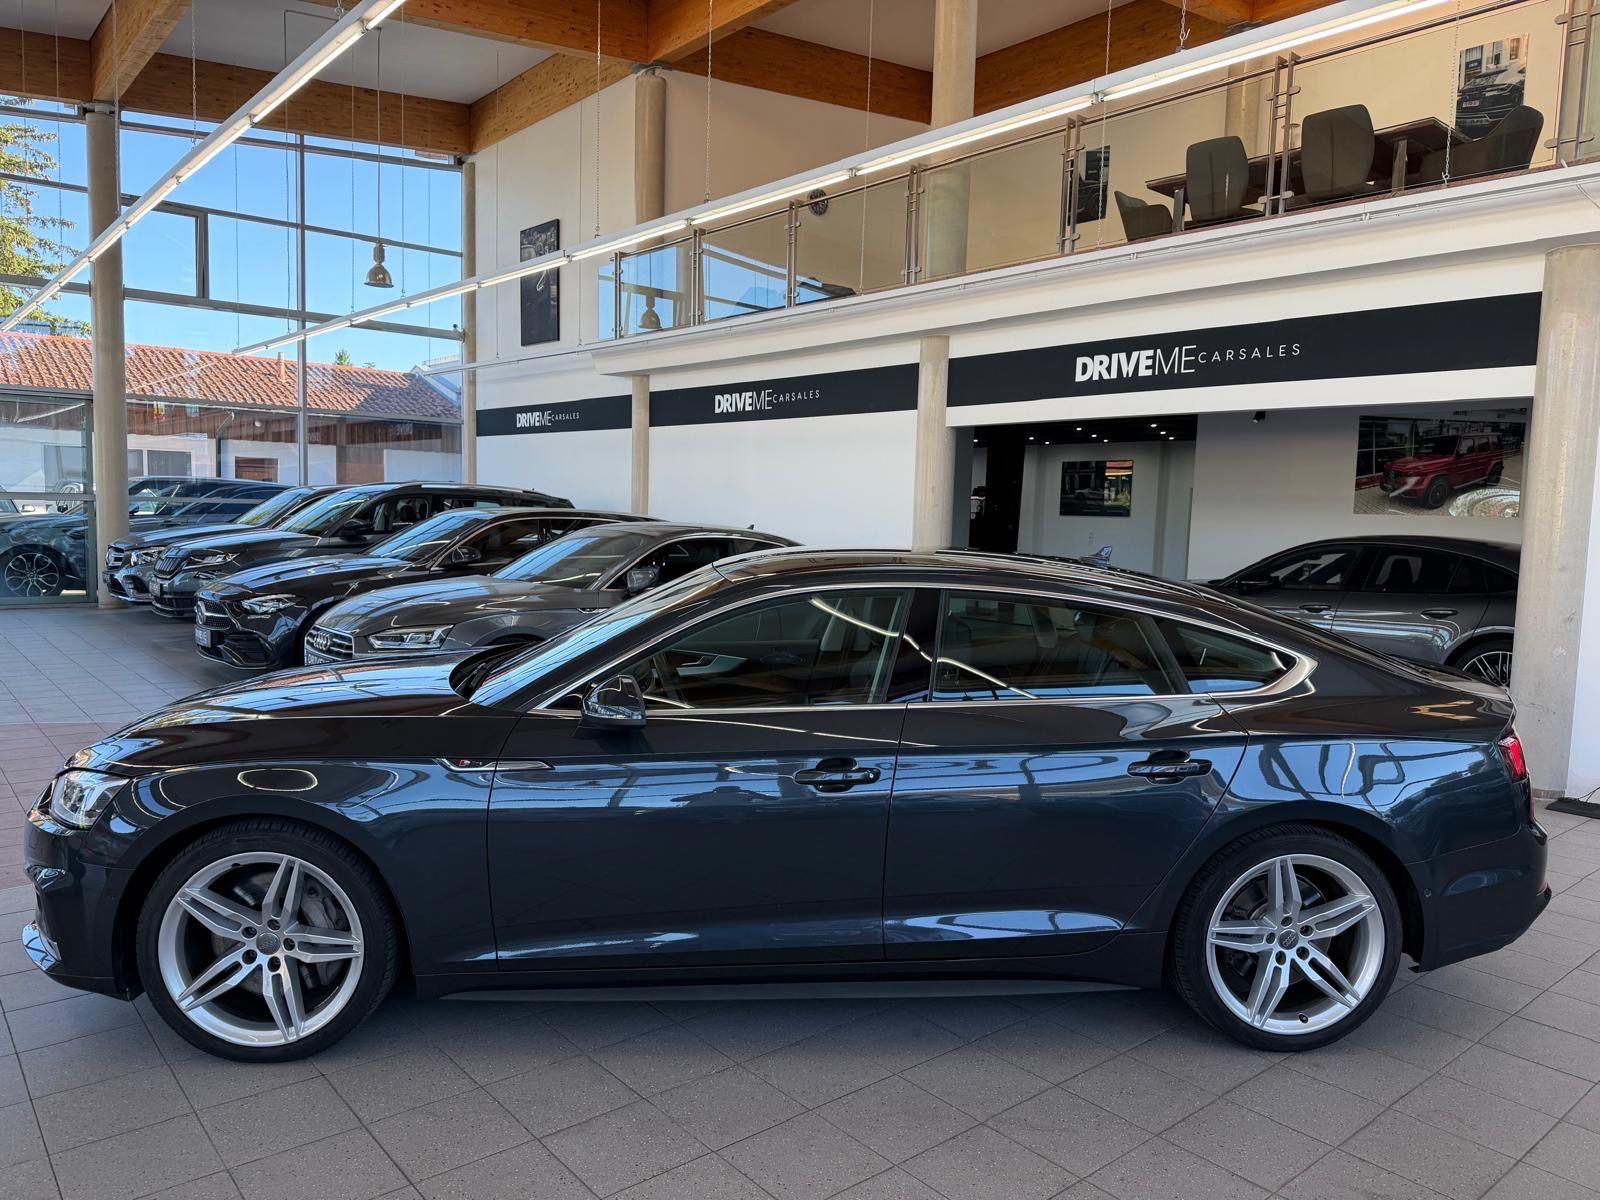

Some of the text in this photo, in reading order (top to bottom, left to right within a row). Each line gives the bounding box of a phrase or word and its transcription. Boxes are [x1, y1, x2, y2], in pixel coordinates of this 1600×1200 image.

[1198, 343, 1301, 364] CARSALES
[772, 389, 820, 404] CARSALES
[551, 411, 580, 421] CARSALES
